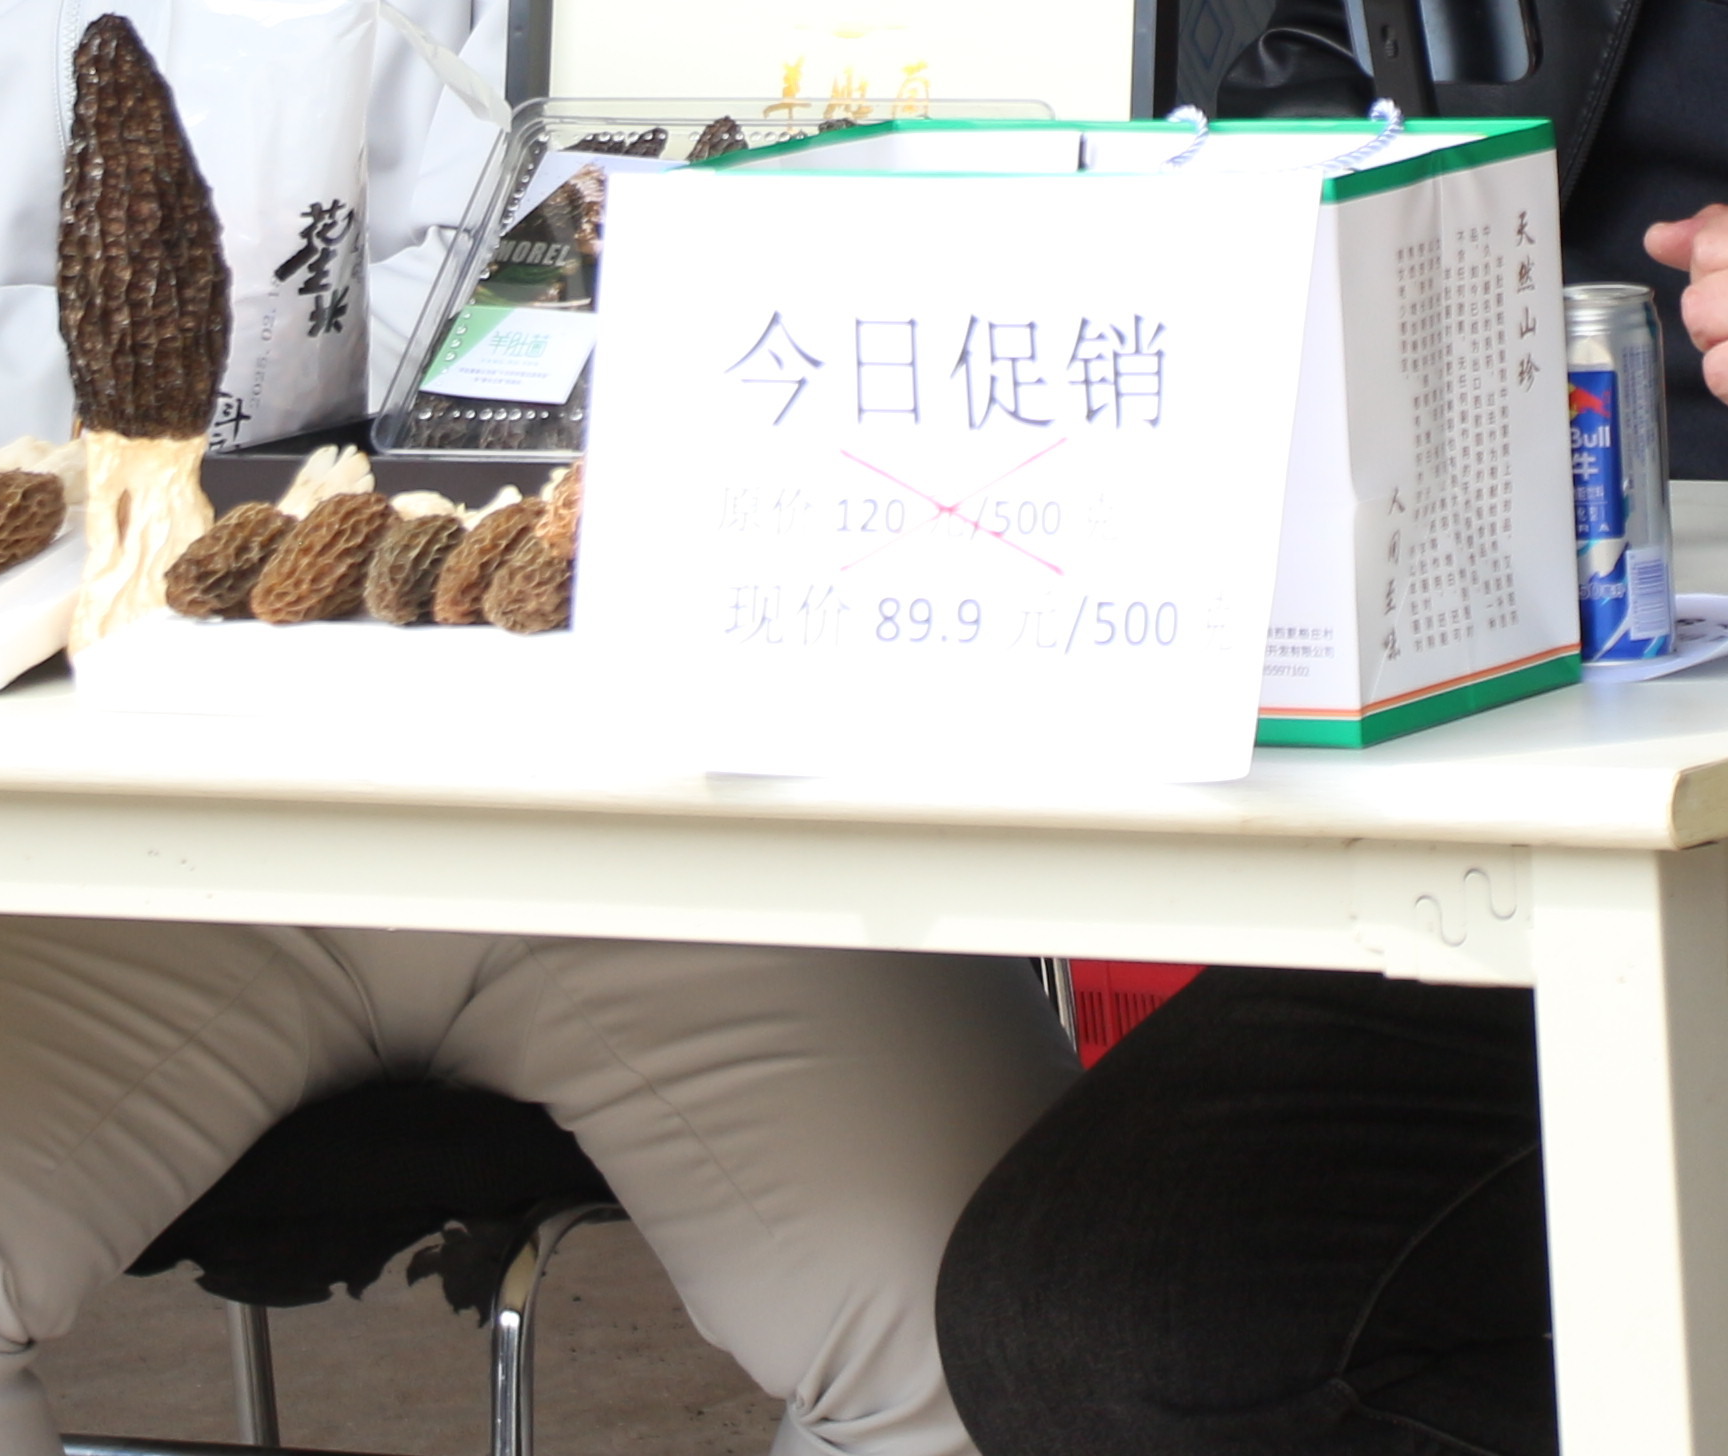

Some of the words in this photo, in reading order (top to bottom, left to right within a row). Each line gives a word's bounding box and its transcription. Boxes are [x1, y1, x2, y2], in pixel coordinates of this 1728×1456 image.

[495, 239, 571, 268] MOREL
[1514, 209, 1541, 393] 天然山珍
[721, 309, 1169, 432] 今日促销
[719, 485, 813, 539] 原价
[834, 498, 907, 535] 120
[725, 582, 853, 647] 现价
[874, 597, 985, 647] 89.9
[1011, 590, 1179, 656] 元/500
